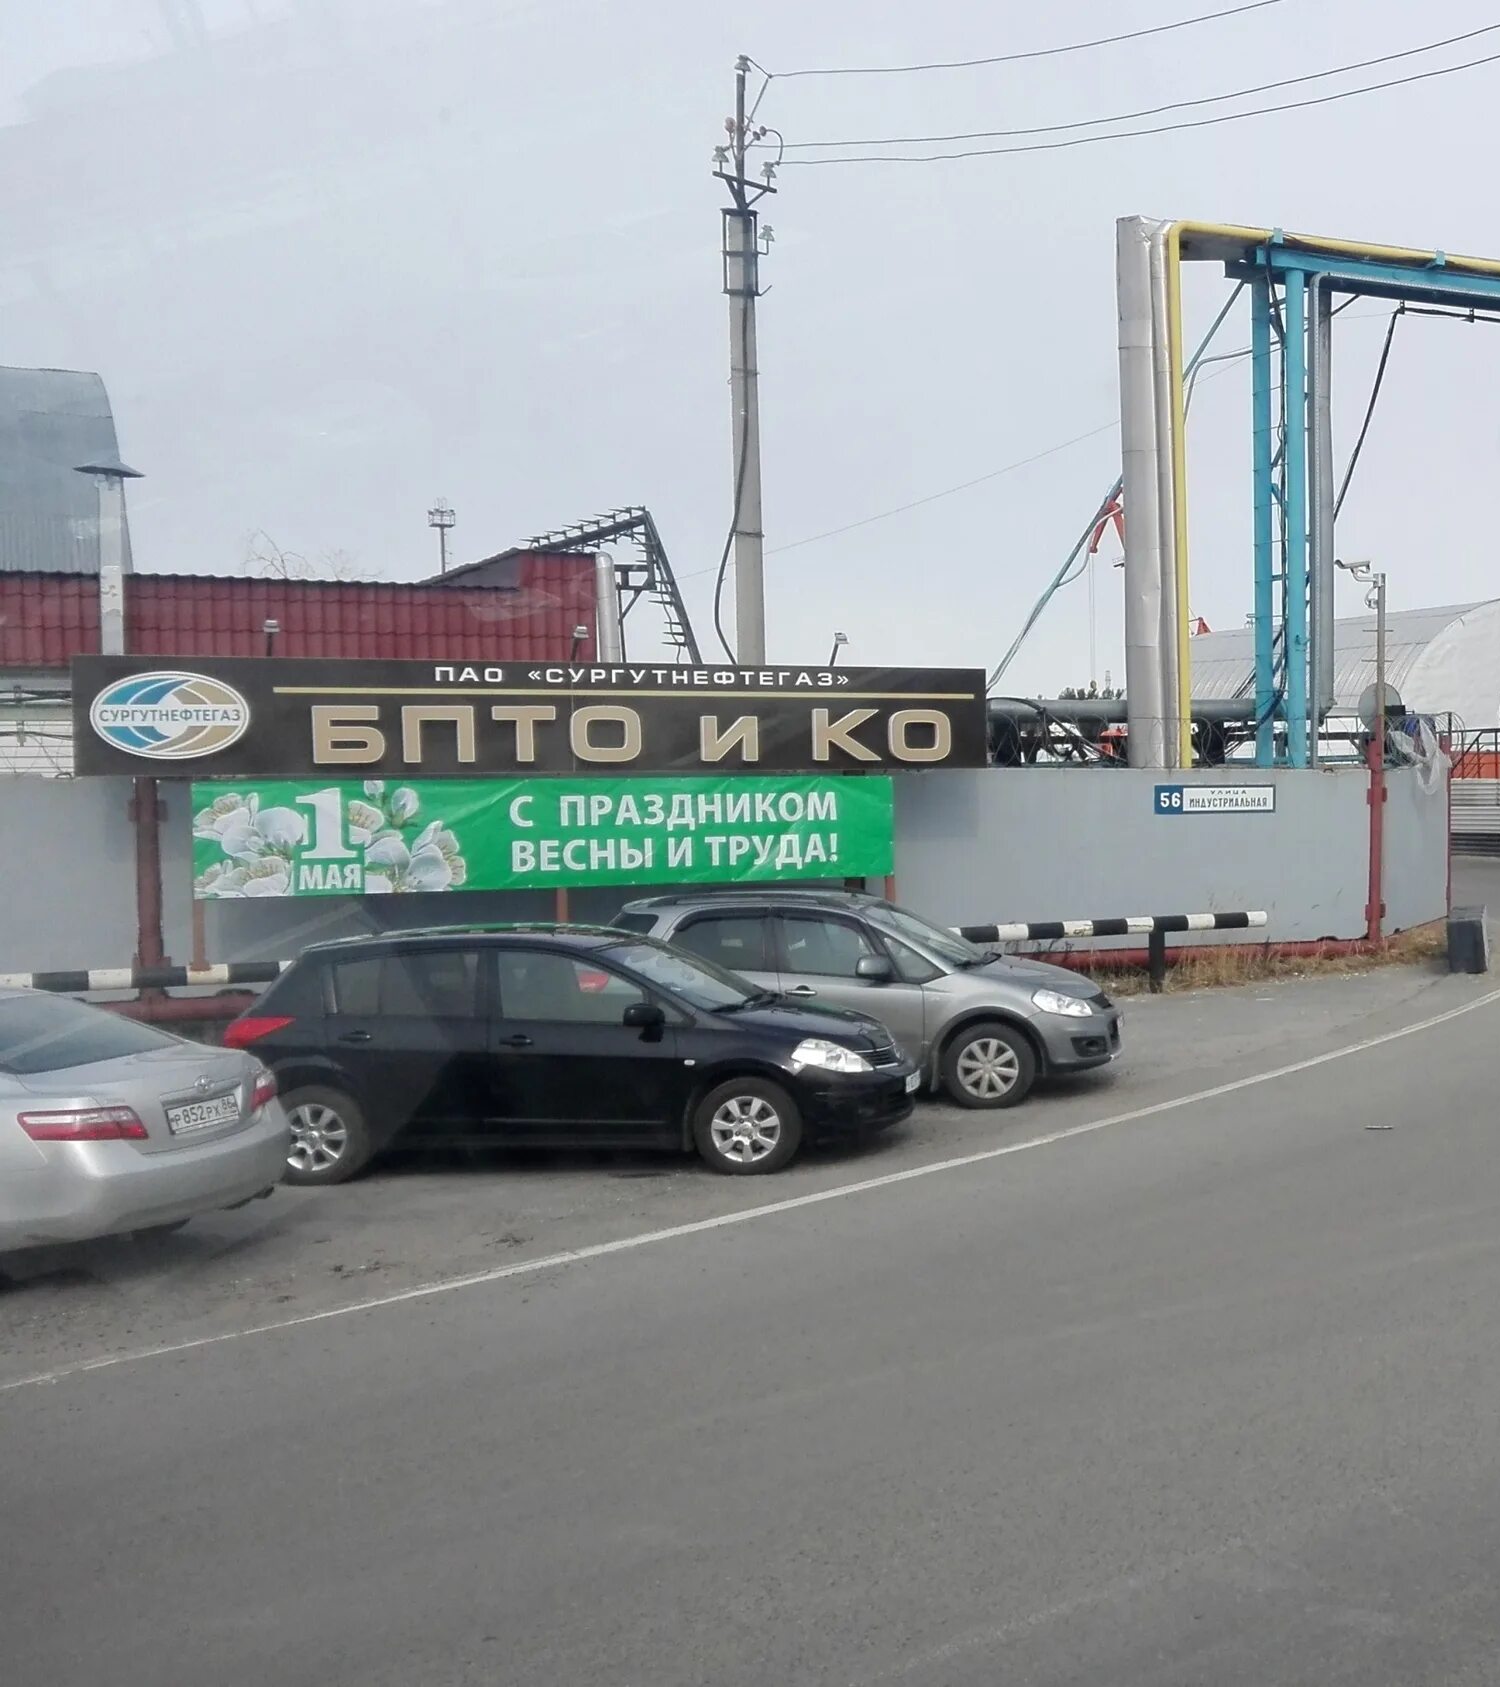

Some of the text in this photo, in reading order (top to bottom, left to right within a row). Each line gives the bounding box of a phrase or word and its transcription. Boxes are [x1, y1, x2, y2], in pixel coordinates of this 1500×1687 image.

[434, 666, 849, 686] ПАО «СУРГУТНЕФТЕГАЗ»
[99, 708, 242, 722] СУРГУТНЕФТЕГАЗ
[312, 705, 642, 765] БПТО
[811, 708, 952, 762] КО
[509, 791, 838, 832] С ПРАЗДНИКОМ
[1160, 792, 1181, 808] 56
[1189, 797, 1268, 808] ИНДУСТРИАЛЬНАЯ
[295, 787, 358, 860] 1
[511, 833, 838, 873] ВЕСНЫ И ТРУДА!
[300, 863, 362, 890] МАЯ
